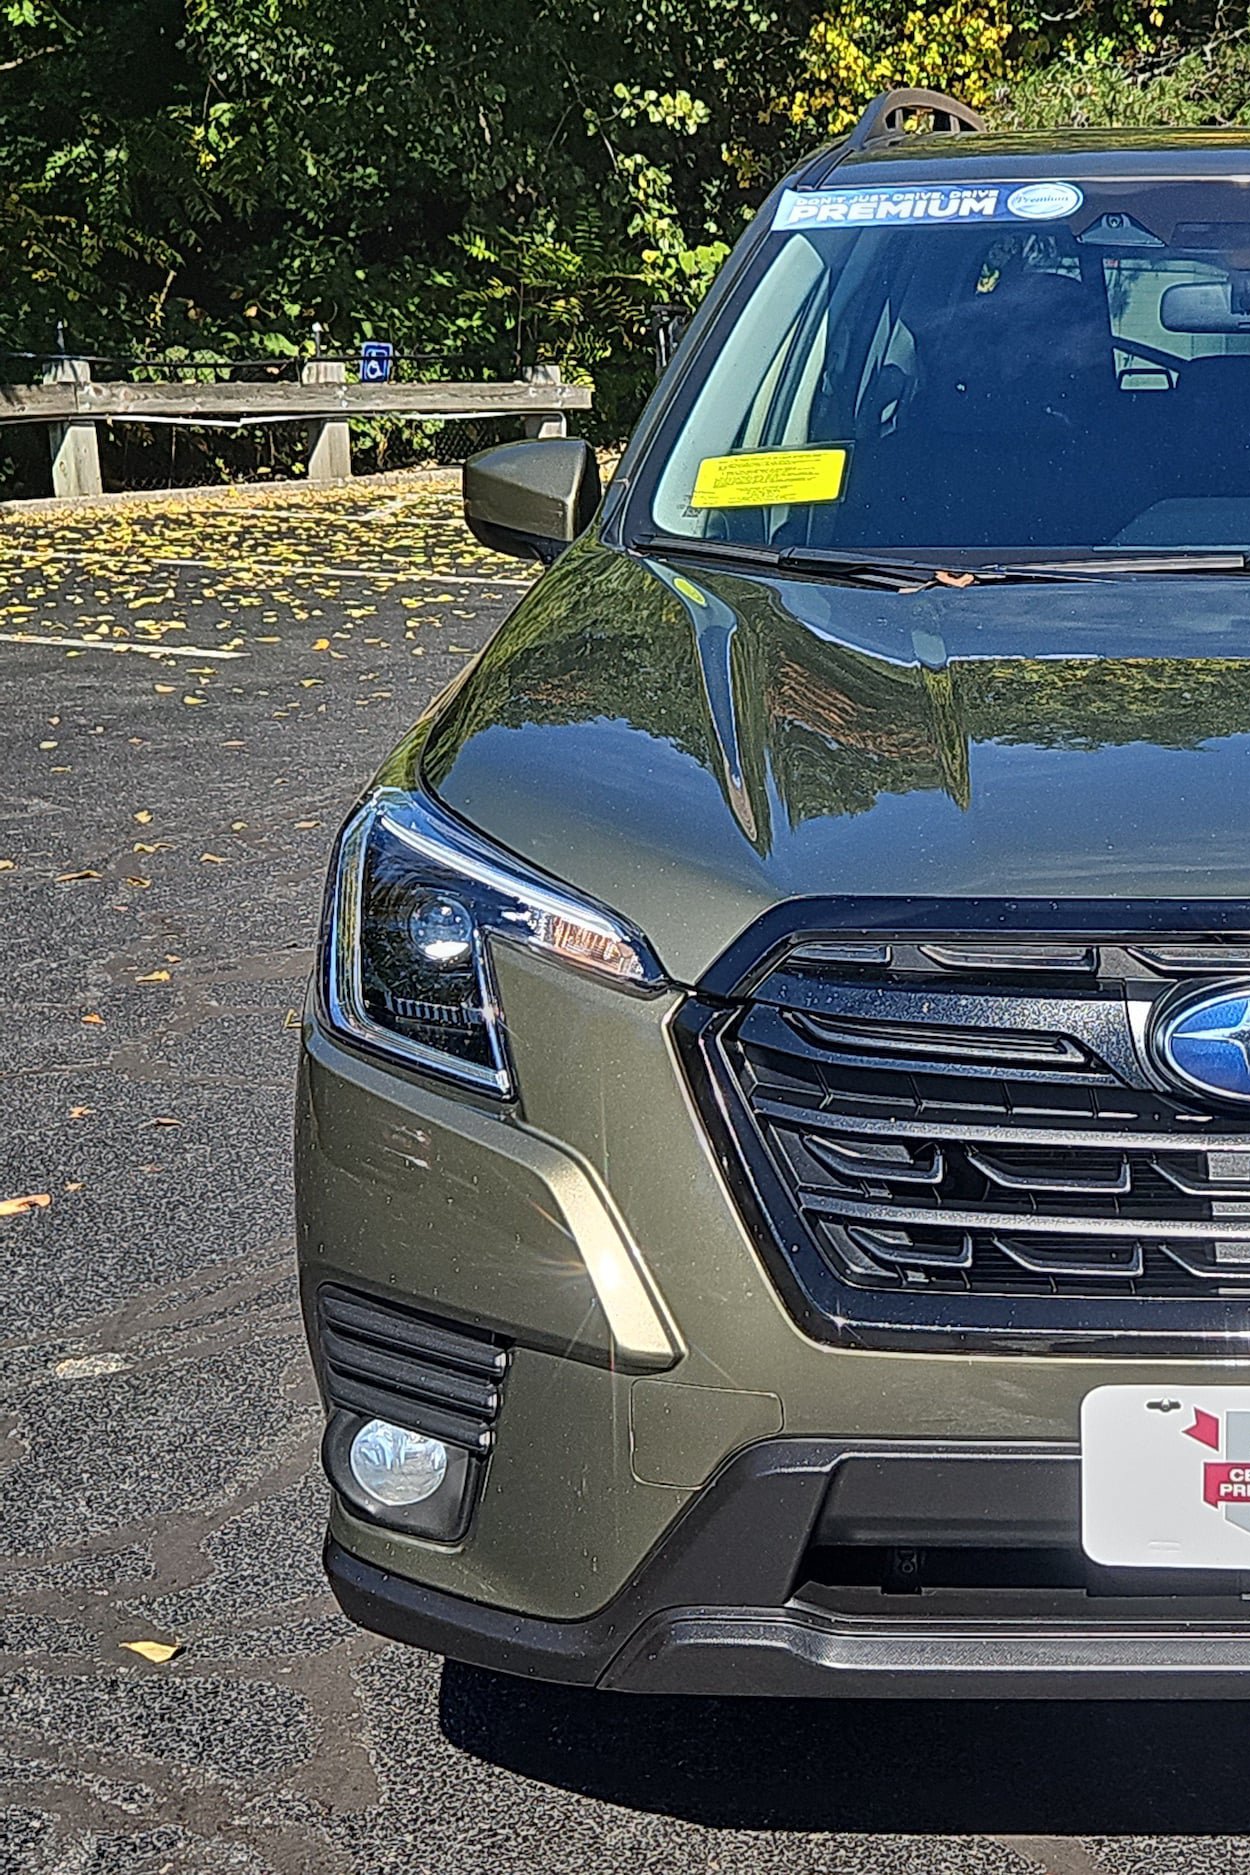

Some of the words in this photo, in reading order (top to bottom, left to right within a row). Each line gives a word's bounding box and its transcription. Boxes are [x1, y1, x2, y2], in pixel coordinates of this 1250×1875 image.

[795, 196, 846, 206] DON'T
[849, 194, 889, 203] JUST
[949, 190, 999, 199] DRIVE
[787, 197, 998, 225] PREMIUM
